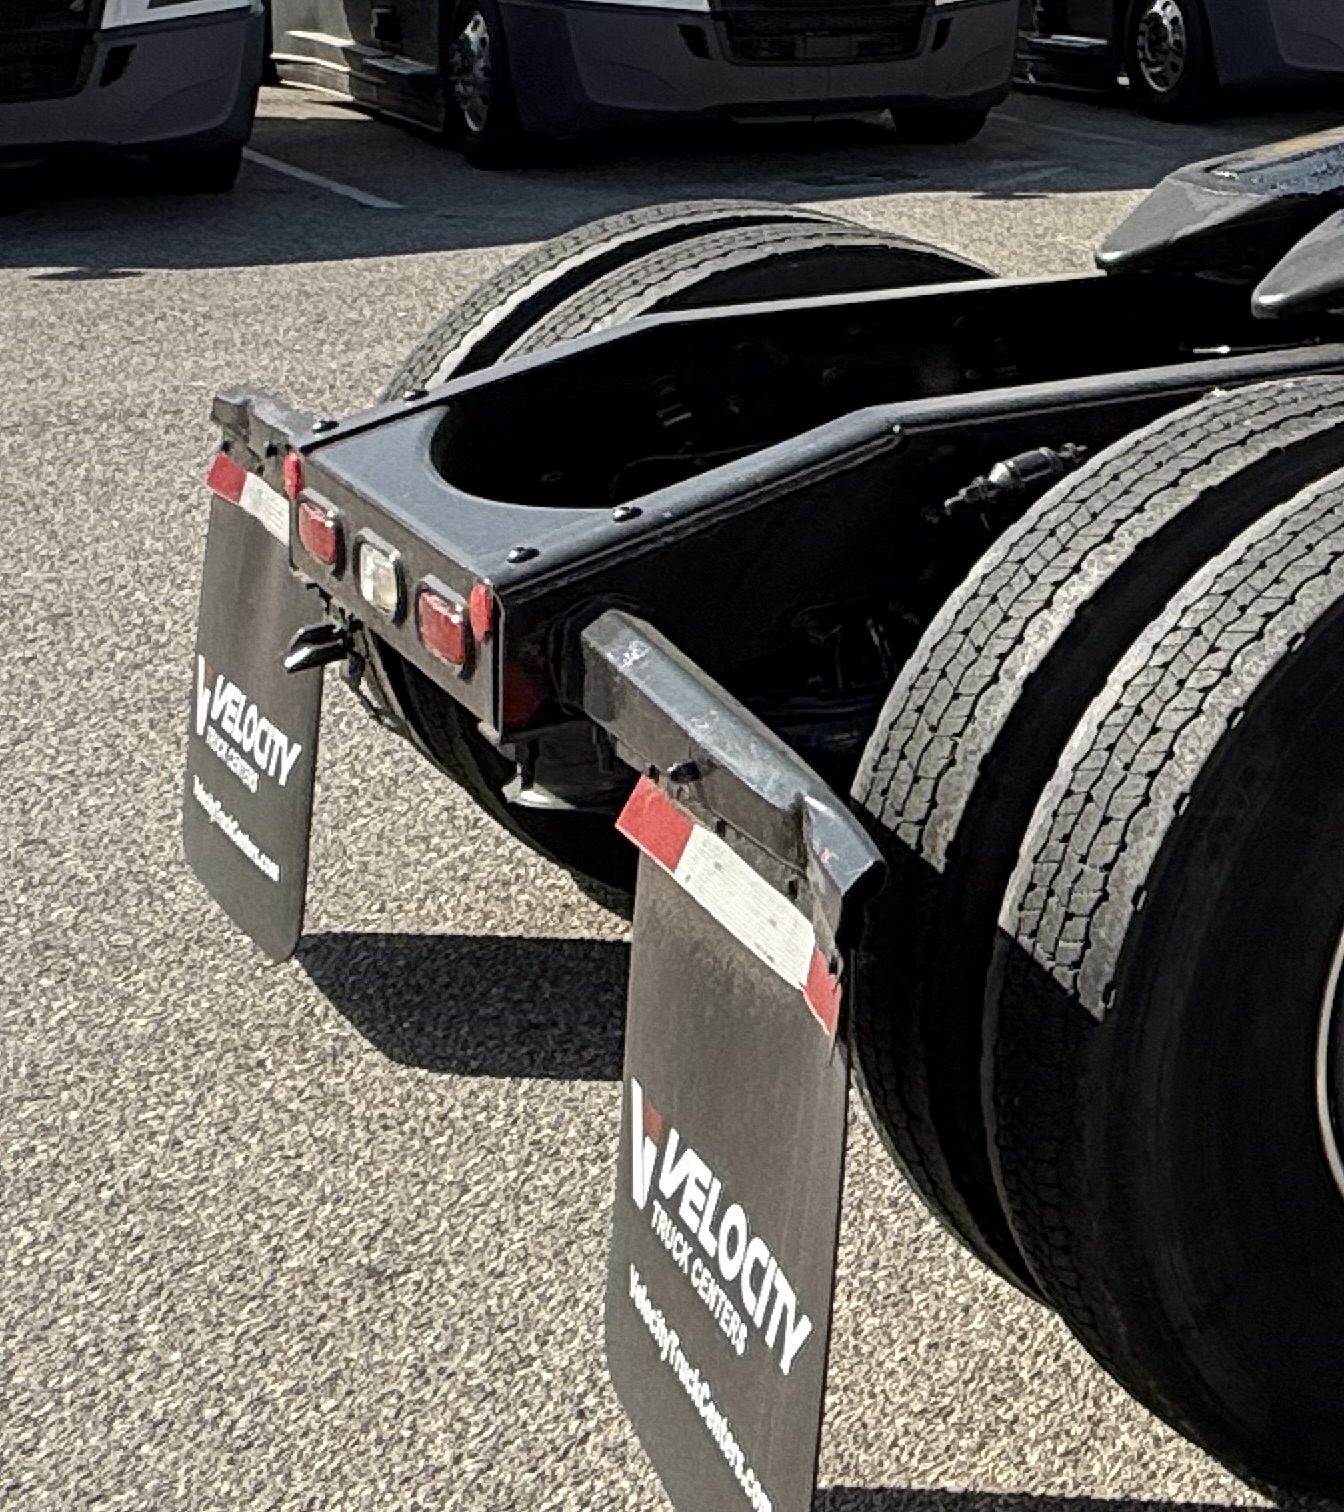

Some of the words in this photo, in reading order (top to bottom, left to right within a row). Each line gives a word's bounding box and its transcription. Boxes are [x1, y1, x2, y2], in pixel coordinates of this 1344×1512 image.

[211, 674, 302, 786] VELOCITY
[651, 1199, 693, 1274] TRUCK
[690, 1257, 748, 1356] CENTERS
[658, 1127, 813, 1376] VELOCITY
